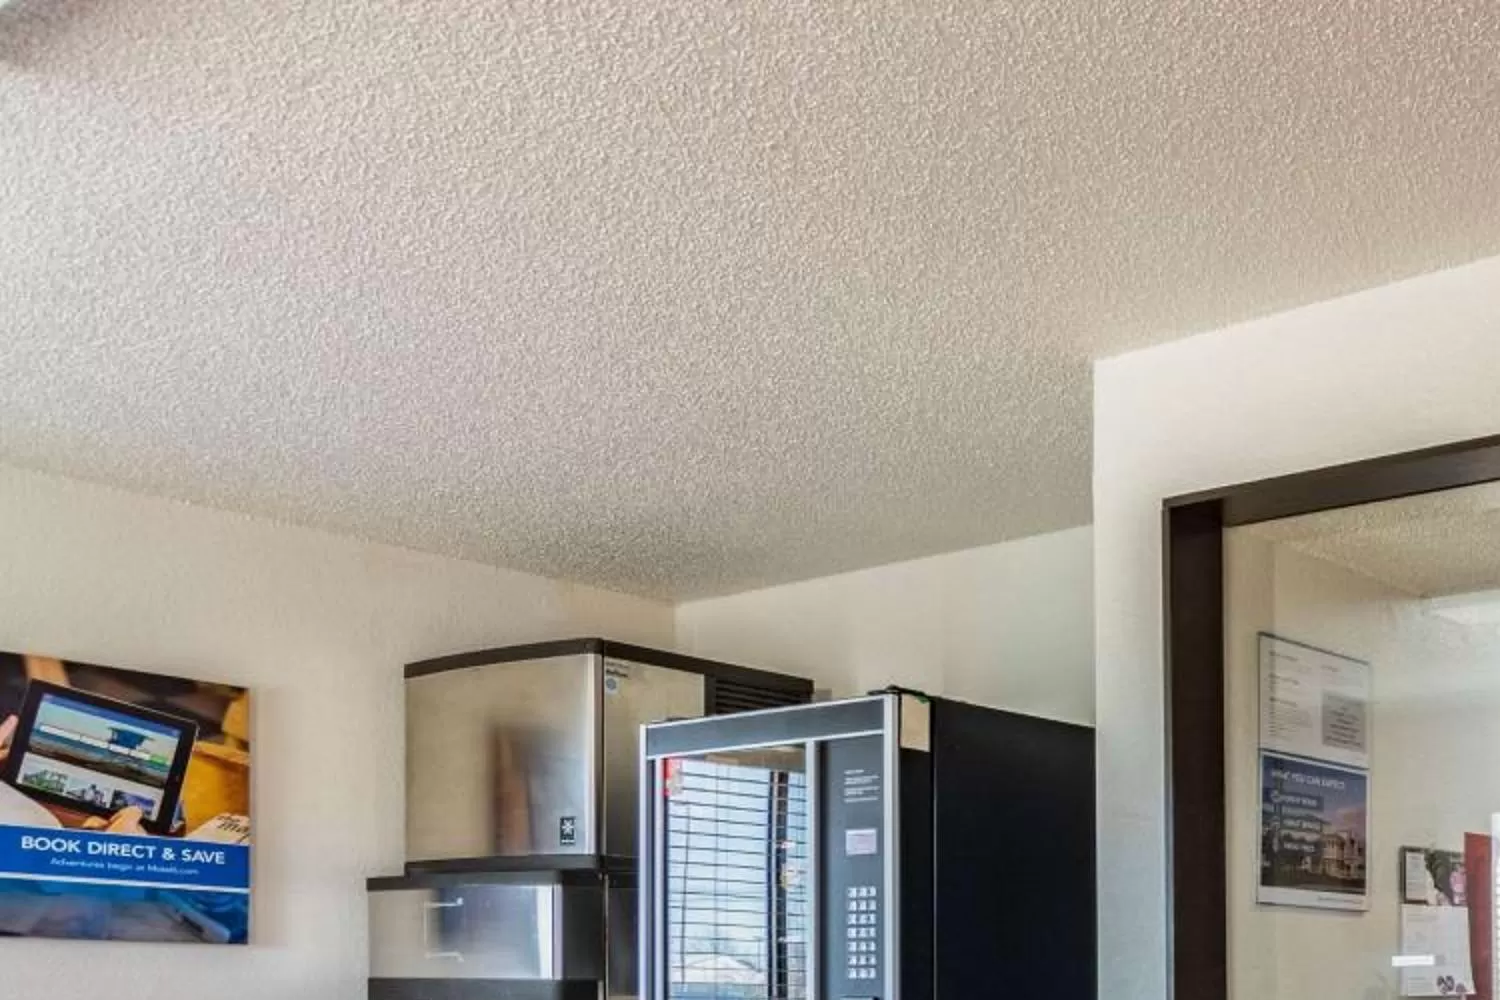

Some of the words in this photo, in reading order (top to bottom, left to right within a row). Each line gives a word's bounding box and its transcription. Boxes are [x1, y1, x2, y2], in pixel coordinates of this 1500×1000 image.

[21, 835, 81, 853] BOOK
[87, 841, 156, 859] DIRECT
[161, 848, 175, 861] &
[181, 849, 226, 865] SAVE
